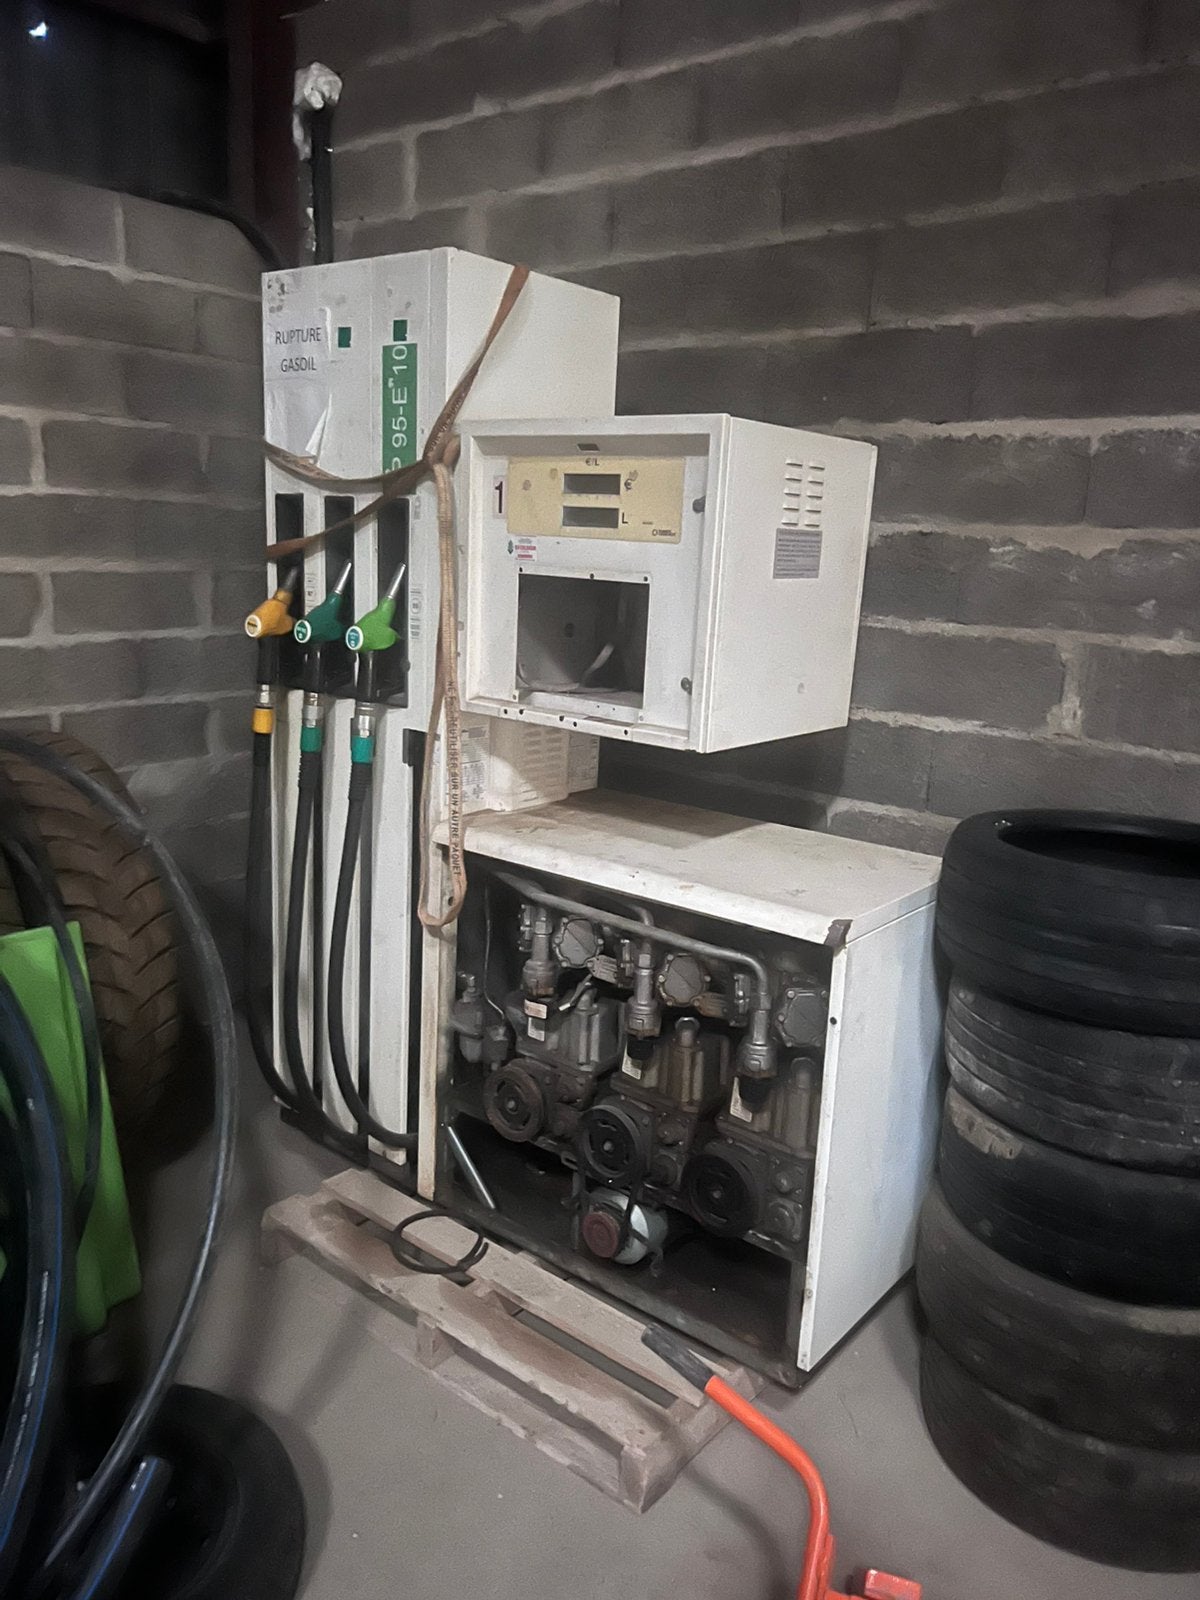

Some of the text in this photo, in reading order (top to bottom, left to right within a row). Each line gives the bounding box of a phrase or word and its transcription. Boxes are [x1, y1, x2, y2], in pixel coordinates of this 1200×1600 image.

[275, 327, 322, 344] RUPTURE
[281, 356, 317, 372] GASOIL
[391, 345, 408, 375] 10
[623, 478, 633, 491] €
[494, 480, 503, 514] 1
[621, 511, 629, 524] L
[450, 773, 459, 790] SUR
[450, 793, 459, 806] UN
[451, 810, 460, 839] AUTRE
[452, 843, 462, 876] PAQUET
